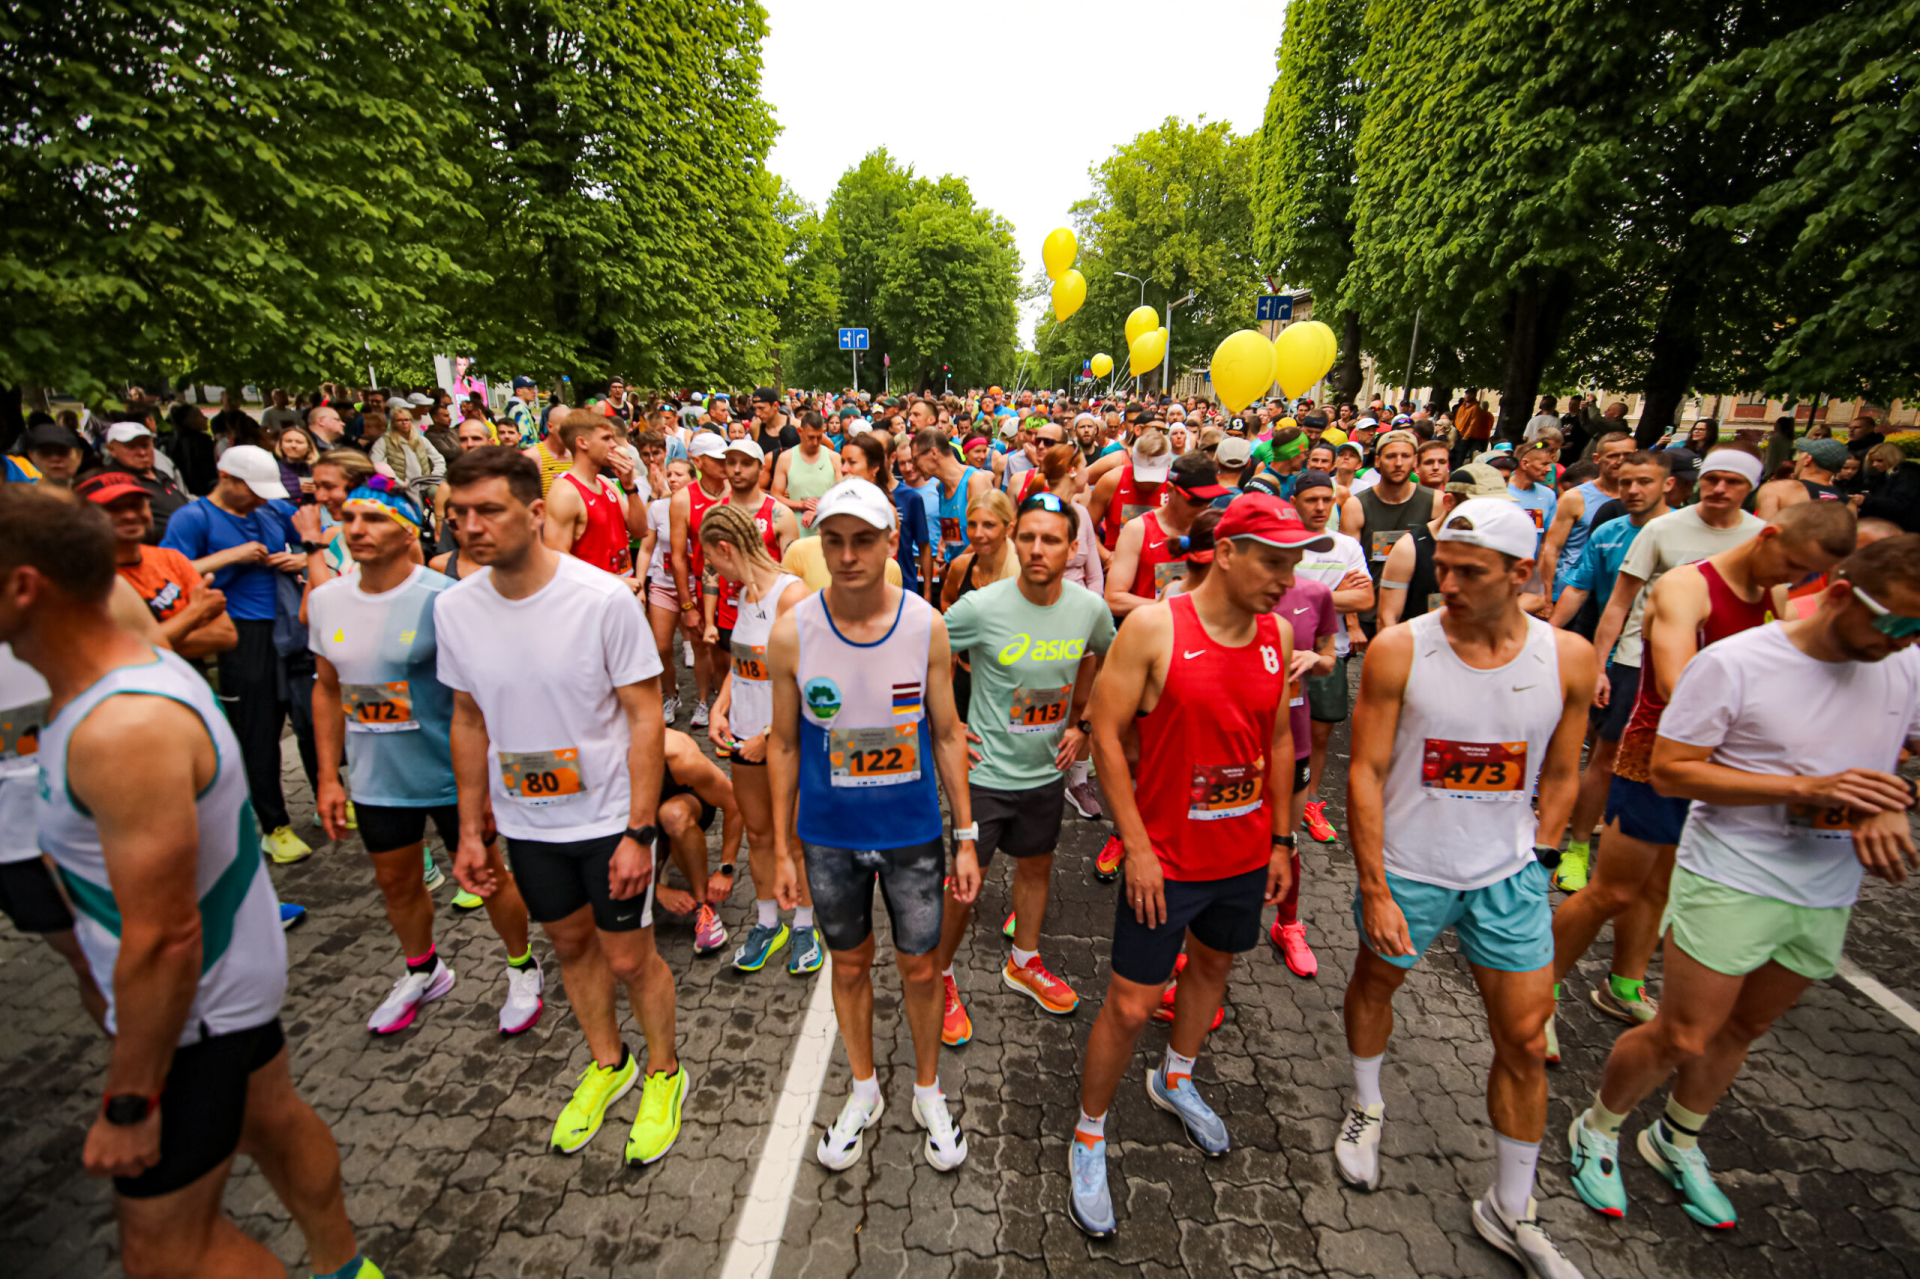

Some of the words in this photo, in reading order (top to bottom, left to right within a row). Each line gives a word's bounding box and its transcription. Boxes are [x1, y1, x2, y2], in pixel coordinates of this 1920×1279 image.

[1030, 638, 1085, 661] asics
[736, 658, 760, 678] 118
[356, 701, 400, 720] 172
[1025, 702, 1062, 723] 113
[850, 748, 904, 772] 122
[525, 771, 560, 794] 80
[1444, 761, 1507, 785] 473
[1208, 780, 1255, 805] 339
